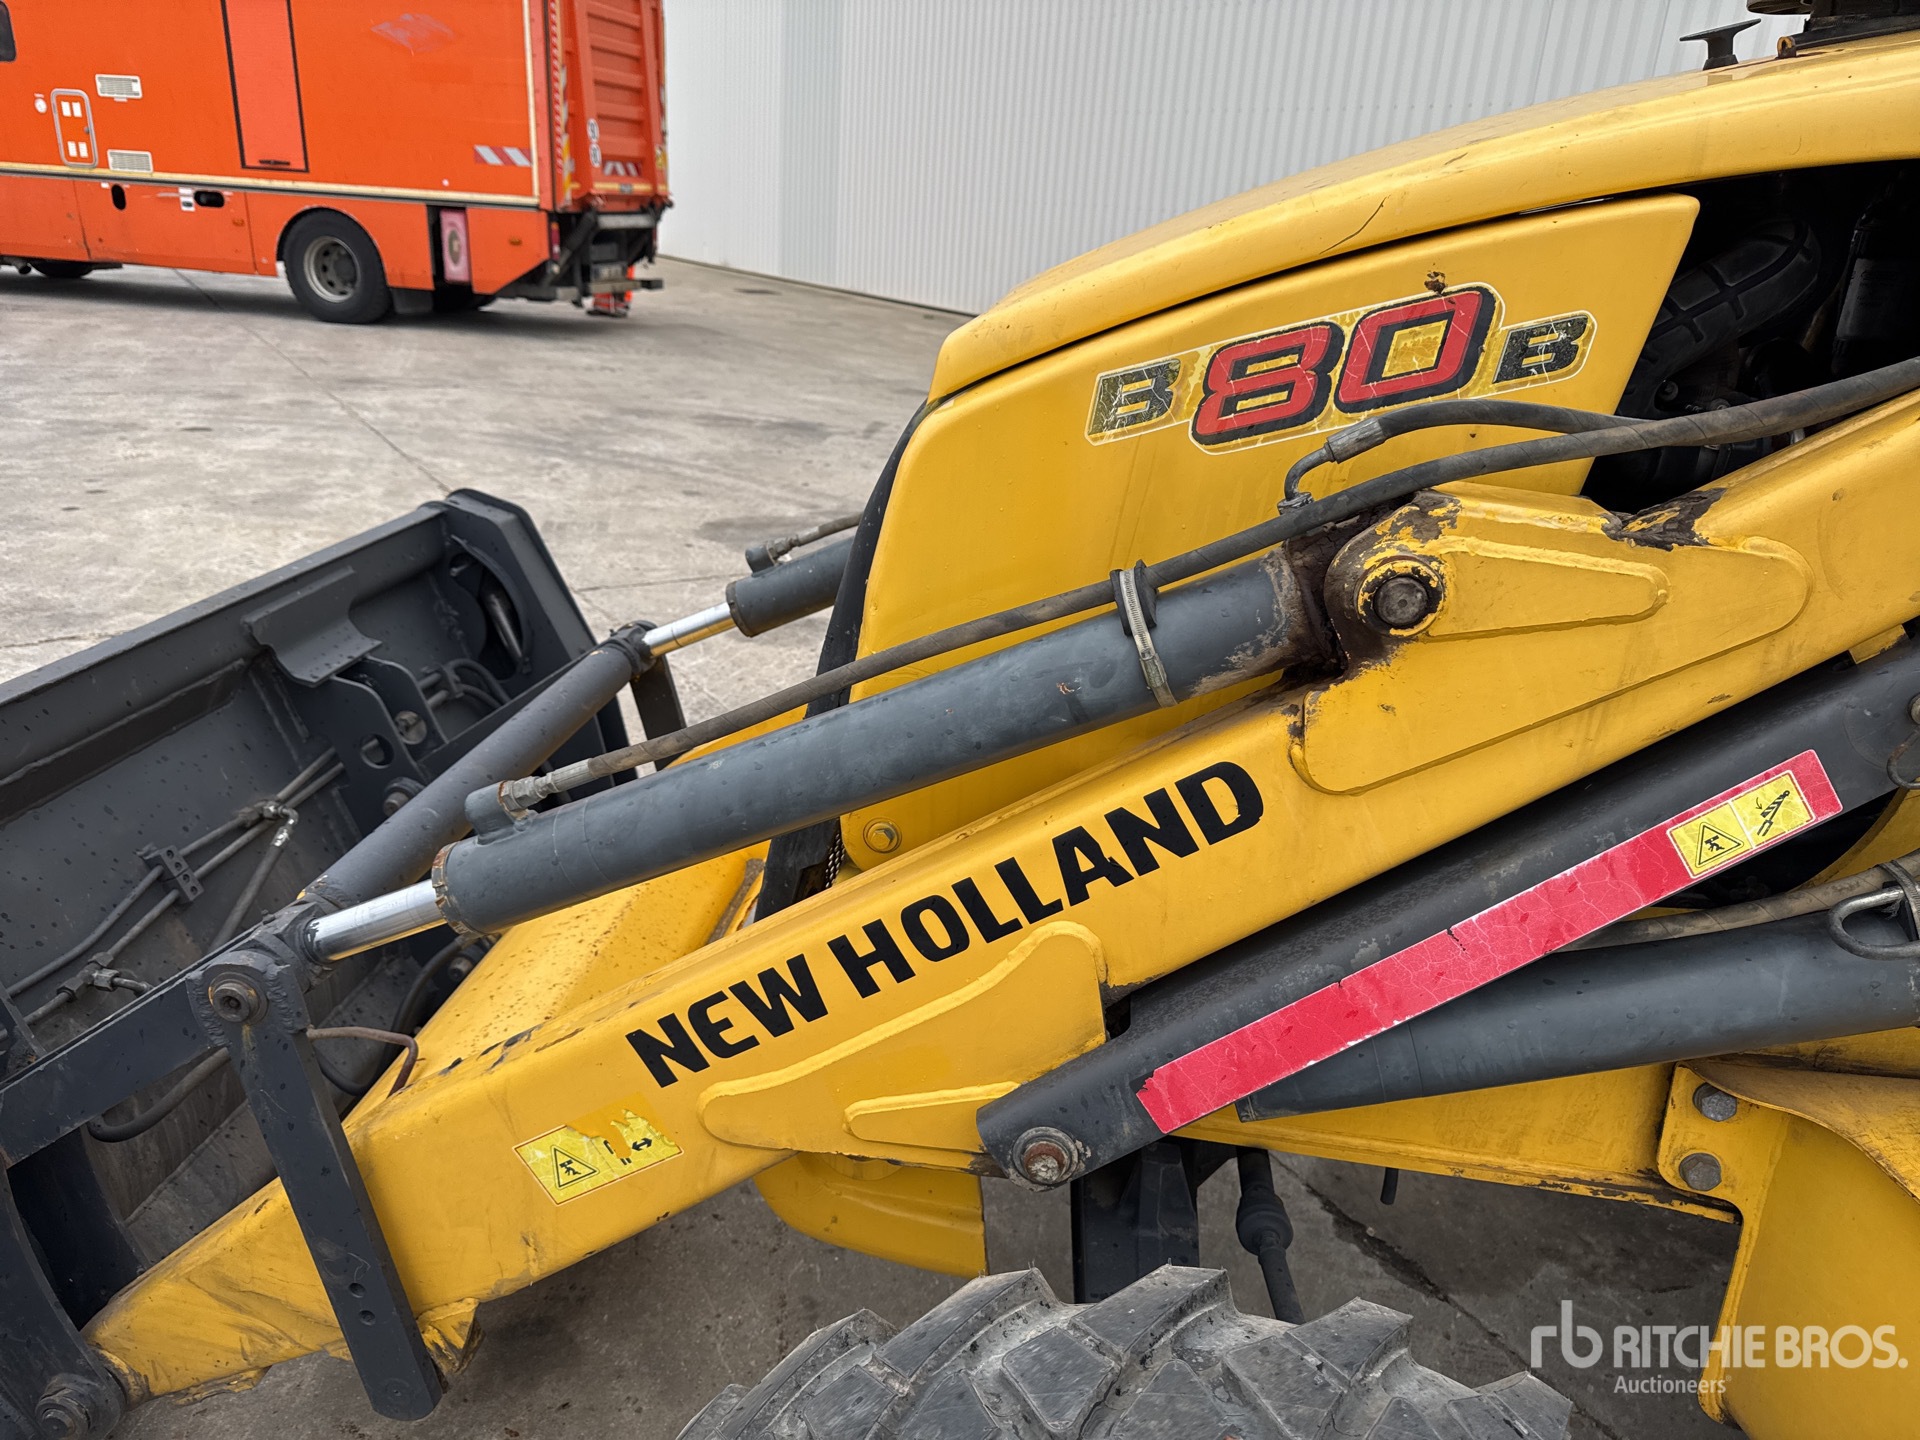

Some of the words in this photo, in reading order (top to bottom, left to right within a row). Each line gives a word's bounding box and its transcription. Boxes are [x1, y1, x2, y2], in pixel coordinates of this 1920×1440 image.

[1087, 358, 1181, 437] B
[1193, 284, 1496, 445] 80
[1491, 314, 1589, 385] B
[625, 953, 829, 1088] NEW
[827, 761, 1264, 999] HOLLAND
